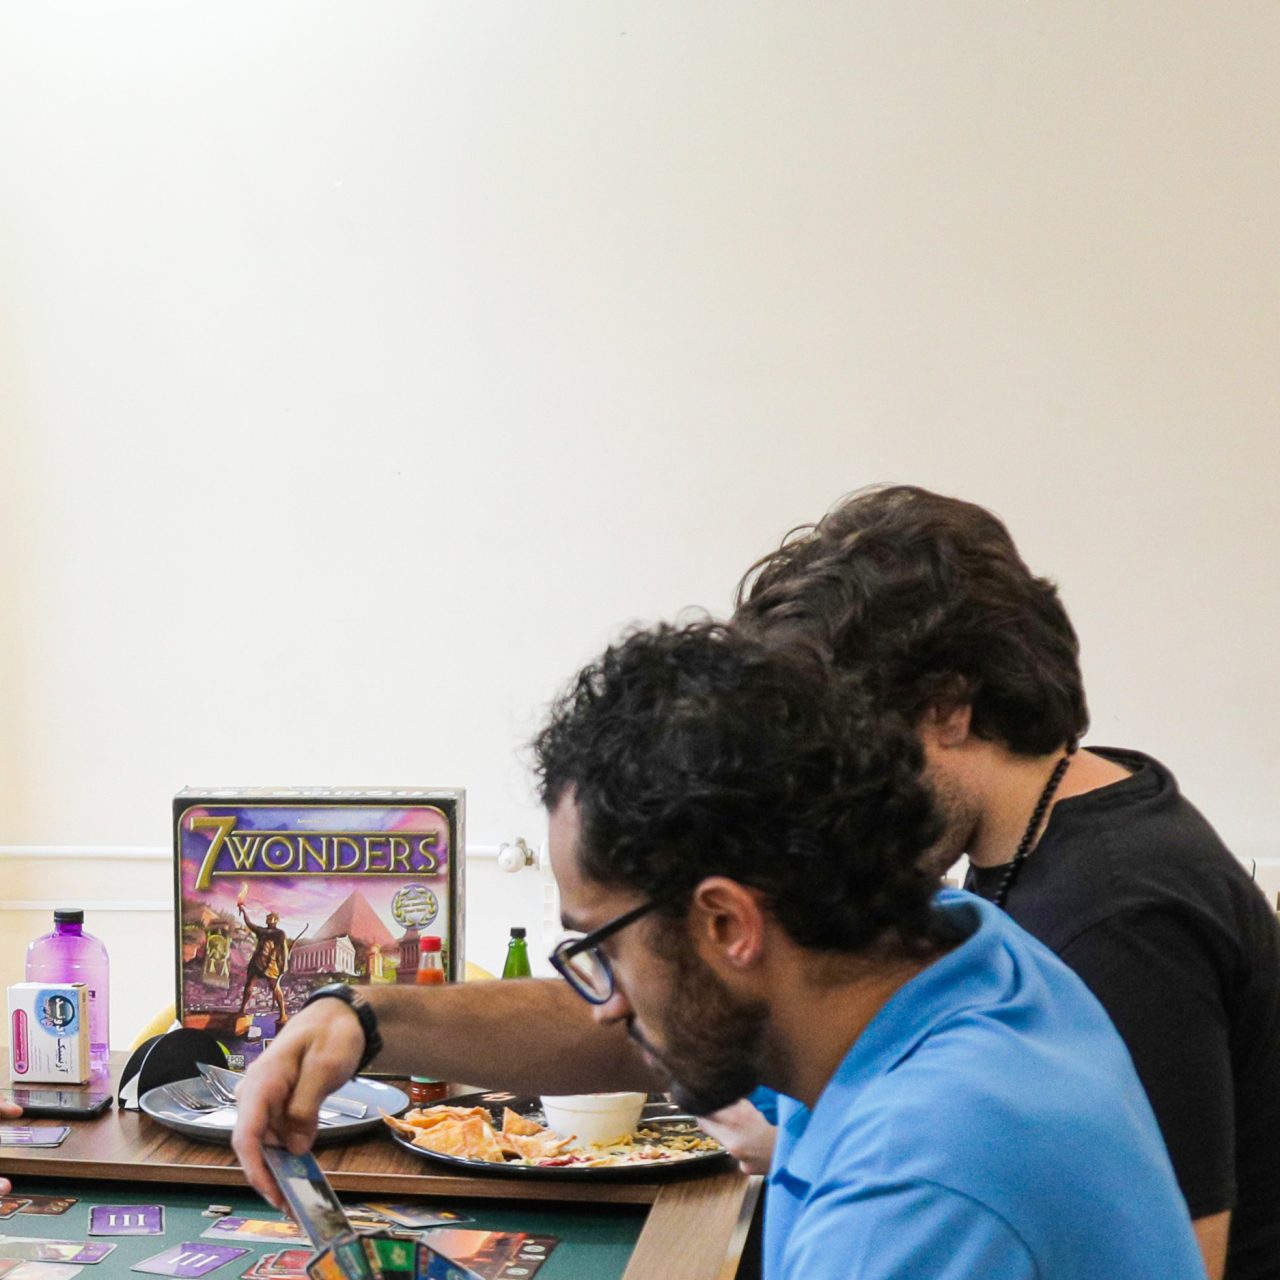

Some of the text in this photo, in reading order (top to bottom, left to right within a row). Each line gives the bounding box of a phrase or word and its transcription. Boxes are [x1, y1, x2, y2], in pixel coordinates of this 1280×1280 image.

[190, 815, 438, 890] 7 WONDERS
[109, 1213, 145, 1227] III
[166, 1252, 220, 1268] III
